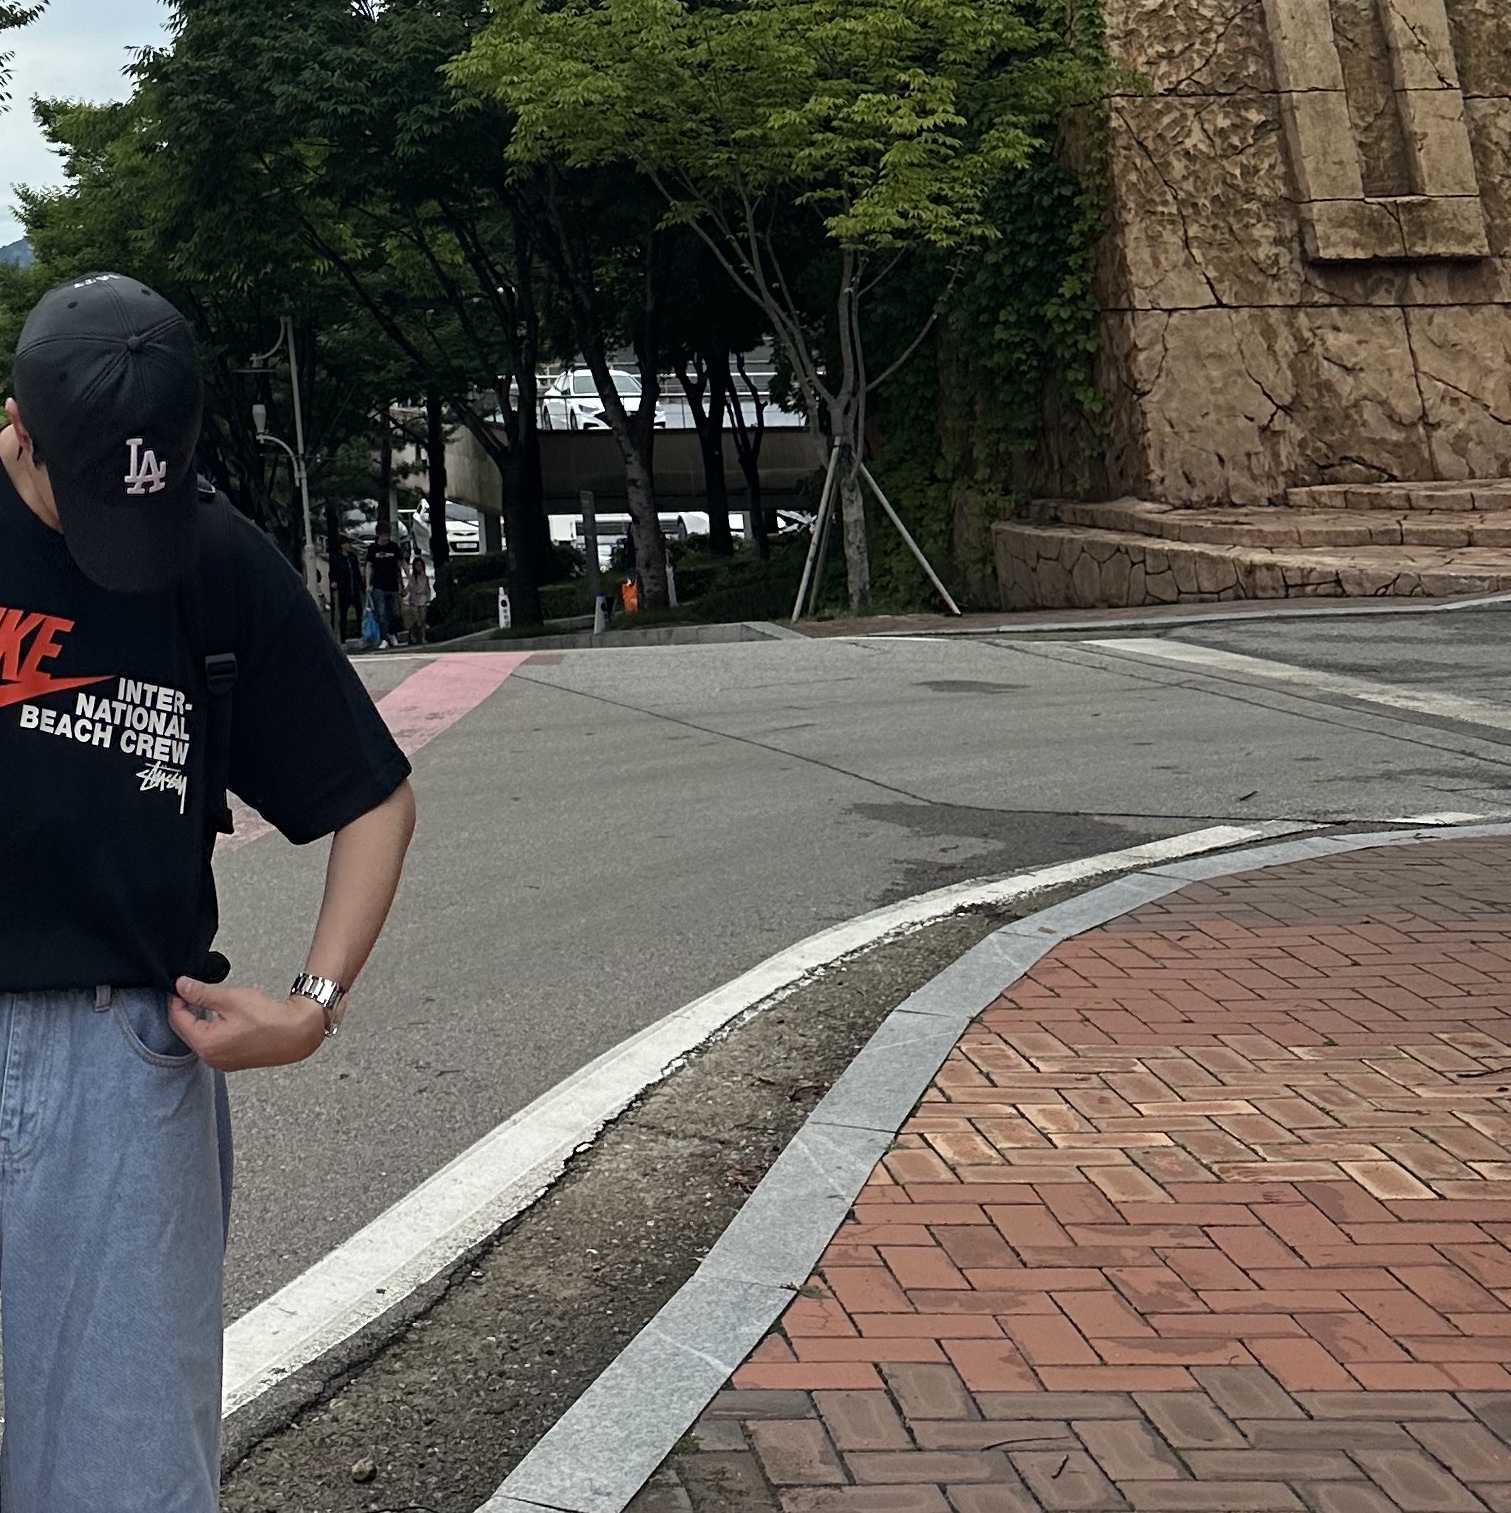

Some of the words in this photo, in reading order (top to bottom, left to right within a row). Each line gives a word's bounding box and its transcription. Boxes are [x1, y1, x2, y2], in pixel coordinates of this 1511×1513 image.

[124, 437, 167, 494] LA
[75, 692, 190, 741] NATIONAL
[117, 677, 193, 714] INTER-
[19, 704, 114, 749] BEACH
[120, 729, 189, 766] CREW
